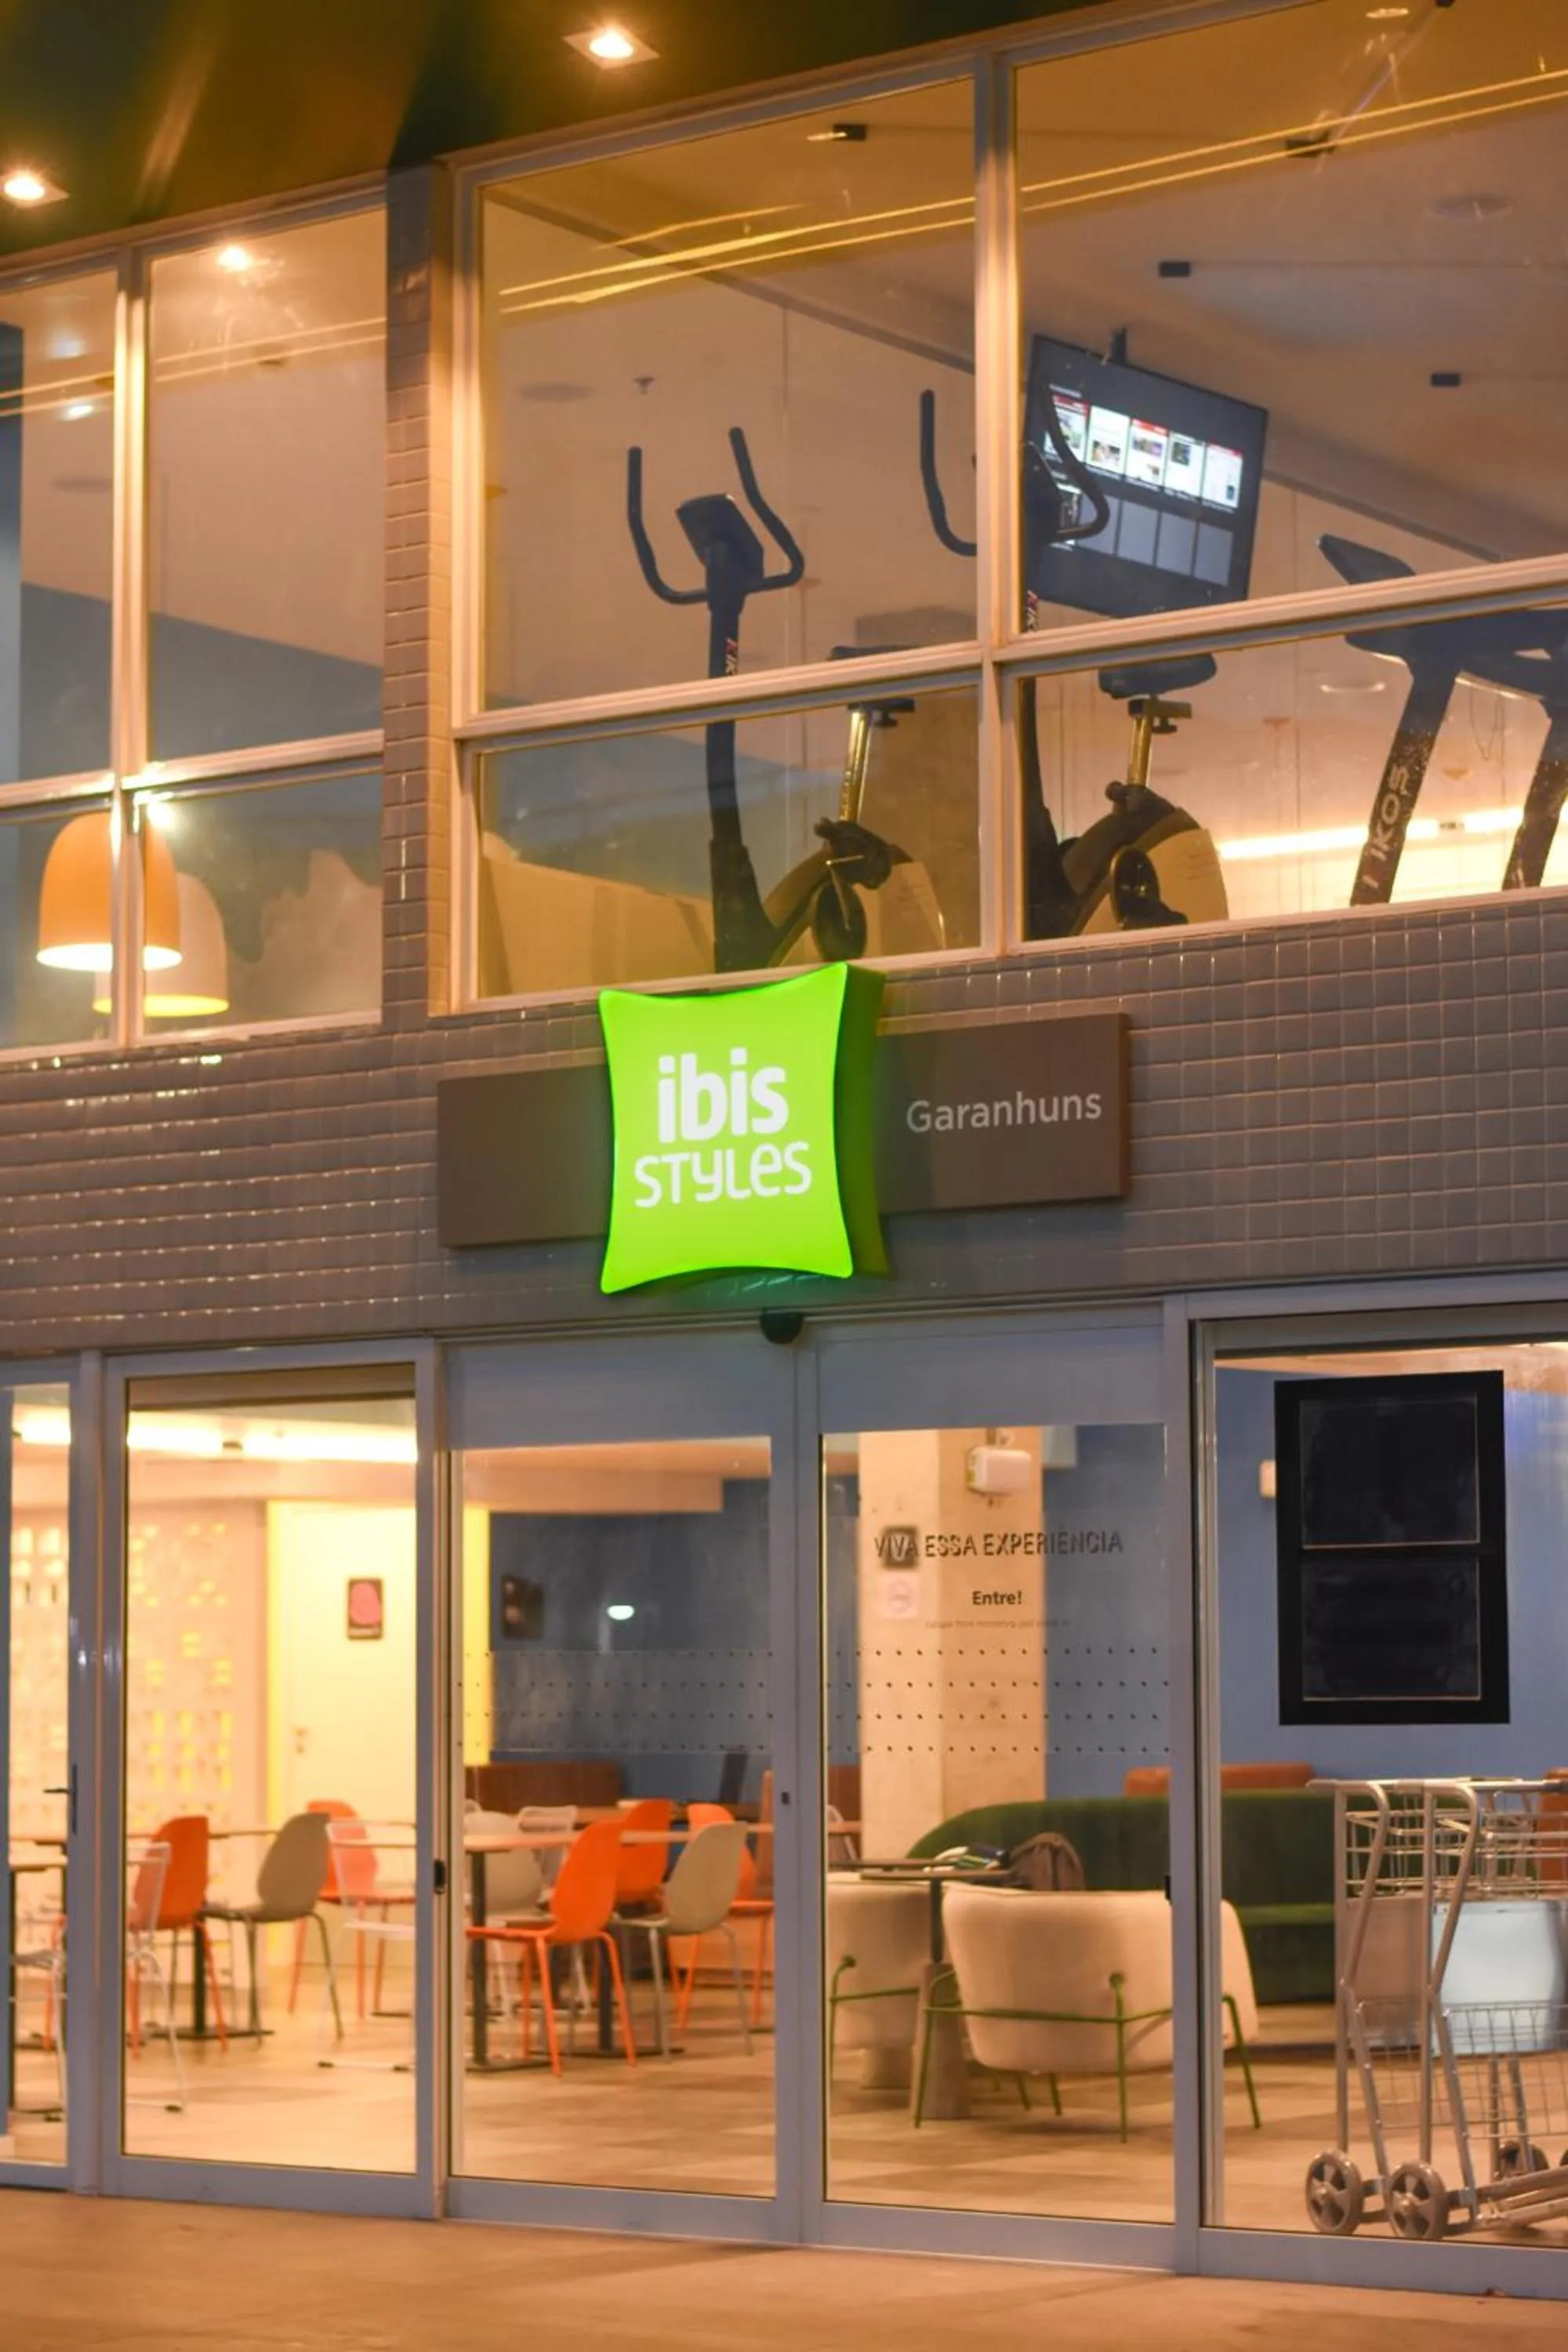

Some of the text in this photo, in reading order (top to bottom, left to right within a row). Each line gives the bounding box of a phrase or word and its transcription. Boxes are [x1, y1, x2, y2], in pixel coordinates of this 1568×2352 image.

[657, 1048, 789, 1142] ibis
[906, 1092, 1102, 1133] Garanhuns
[924, 1533, 978, 1558] ESSA
[983, 1525, 1123, 1557] EXPERIÊNCIA
[971, 1590, 1022, 1606] Entre!
